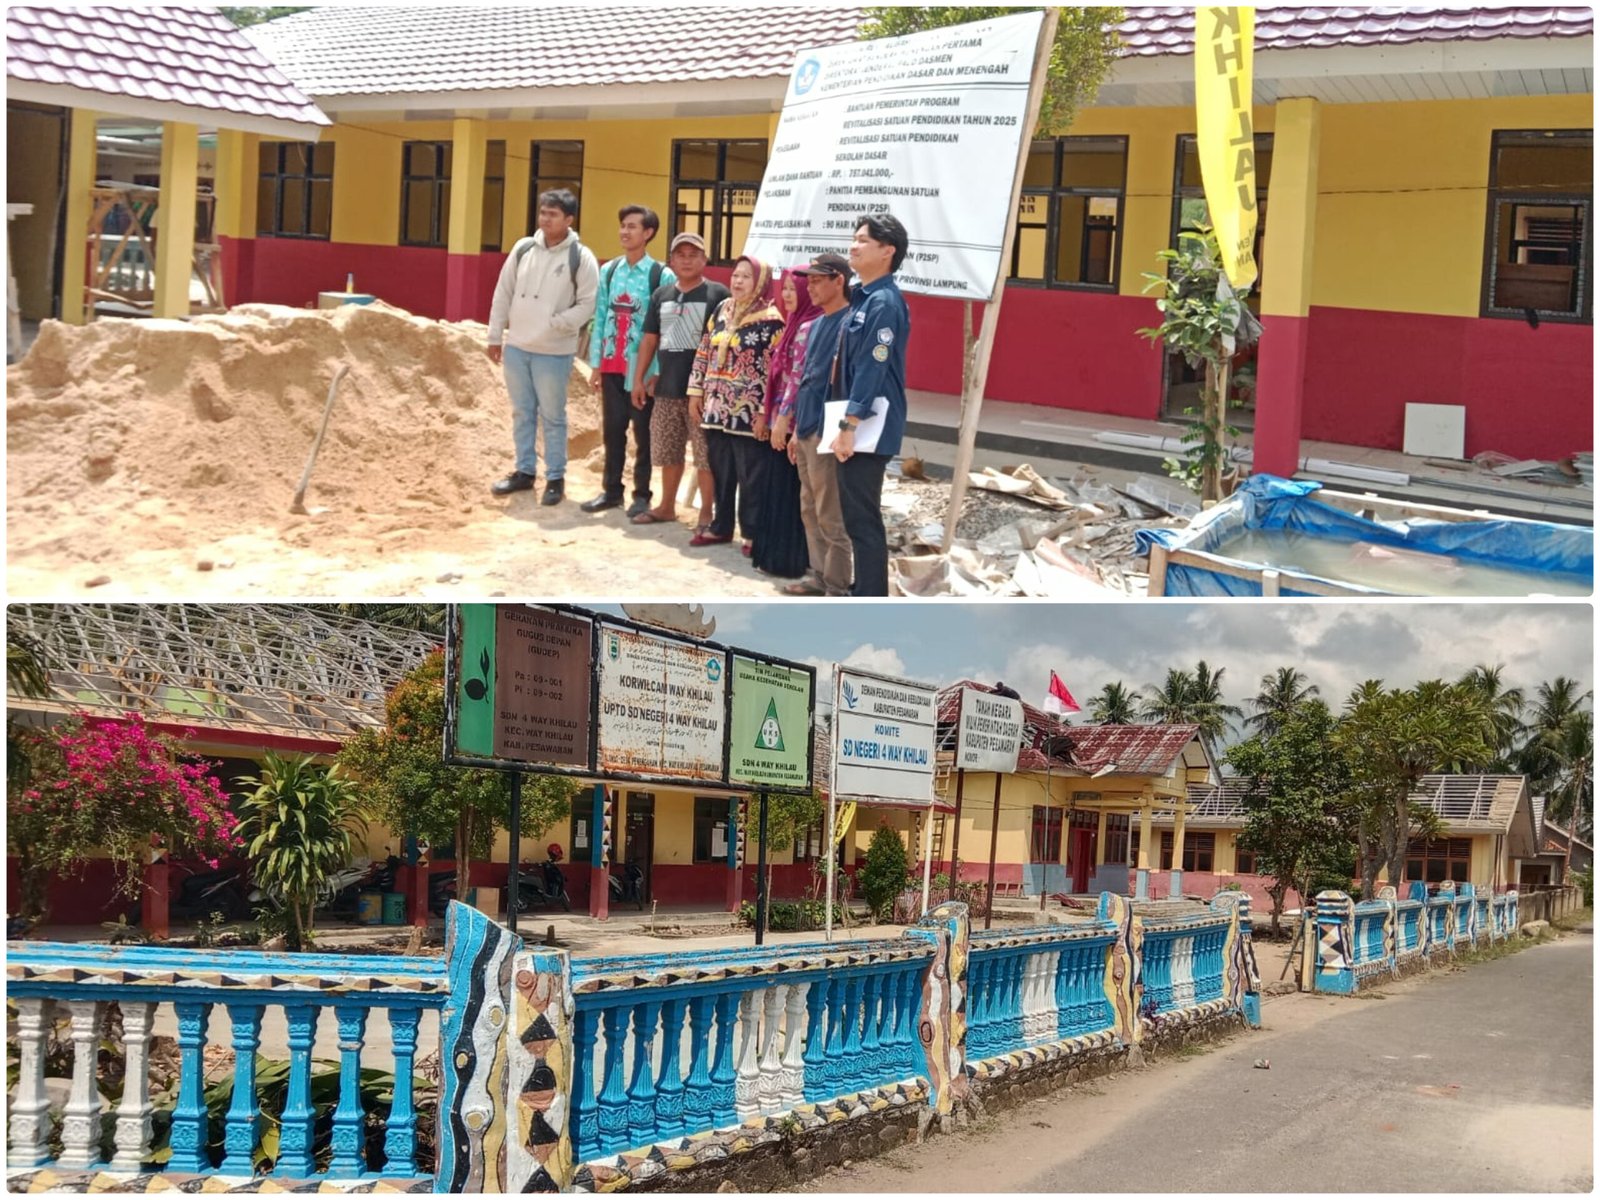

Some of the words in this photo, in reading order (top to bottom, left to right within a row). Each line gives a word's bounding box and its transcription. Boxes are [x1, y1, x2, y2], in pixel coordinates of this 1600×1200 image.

[906, 67, 935, 79] DASAR
[936, 66, 954, 77] DAN
[955, 63, 1010, 75] MENENGAH
[875, 97, 918, 110] PEMERINTAH
[918, 96, 960, 108] PROGRAM
[883, 115, 910, 127] SATUAN
[910, 114, 961, 126] PENDIDIKAN
[962, 115, 992, 126] TAHUN
[993, 115, 1018, 127] 2025
[880, 133, 908, 143] SATUAN
[907, 132, 960, 144] PENDIDIKAN
[834, 151, 864, 162] SEKOLAH
[864, 150, 888, 160] DASAR
[828, 185, 853, 196] PANITIA
[853, 185, 910, 197] PEMBANGUNAN
[910, 186, 940, 198] SATUAN
[827, 202, 866, 213] PENDIDIKAN
[835, 219, 850, 229] HARI
[915, 252, 940, 264] (P2SP)
[899, 274, 932, 284] PROVINSI
[933, 278, 969, 291] LAMPUNG
[504, 610, 544, 628] GERAKAN
[516, 627, 545, 641] GUGUS
[545, 633, 572, 648] DEPAN
[619, 674, 668, 695] KORWILCAM
[668, 683, 686, 698] WAY
[686, 686, 714, 702] KHILAU
[603, 702, 626, 717] UPTD
[627, 705, 639, 719] SD
[639, 708, 668, 724] NEGERI
[668, 713, 674, 725] 4
[675, 713, 692, 728] WAY
[692, 715, 718, 732] KHILAU
[991, 702, 1012, 720] NEGARA
[500, 710, 518, 721] SDN
[530, 715, 548, 726] WAY
[548, 717, 578, 730] KHILAU
[544, 731, 574, 742] KHILAU
[874, 723, 900, 738] KOMITE
[843, 738, 853, 757] SD
[854, 740, 881, 760] NEGERI
[881, 744, 887, 760] 4
[887, 745, 903, 762] WAY
[903, 746, 928, 766] KHILAU
[742, 758, 755, 768] SDN
[760, 760, 774, 769] WAY
[775, 762, 797, 772] KHILAU
